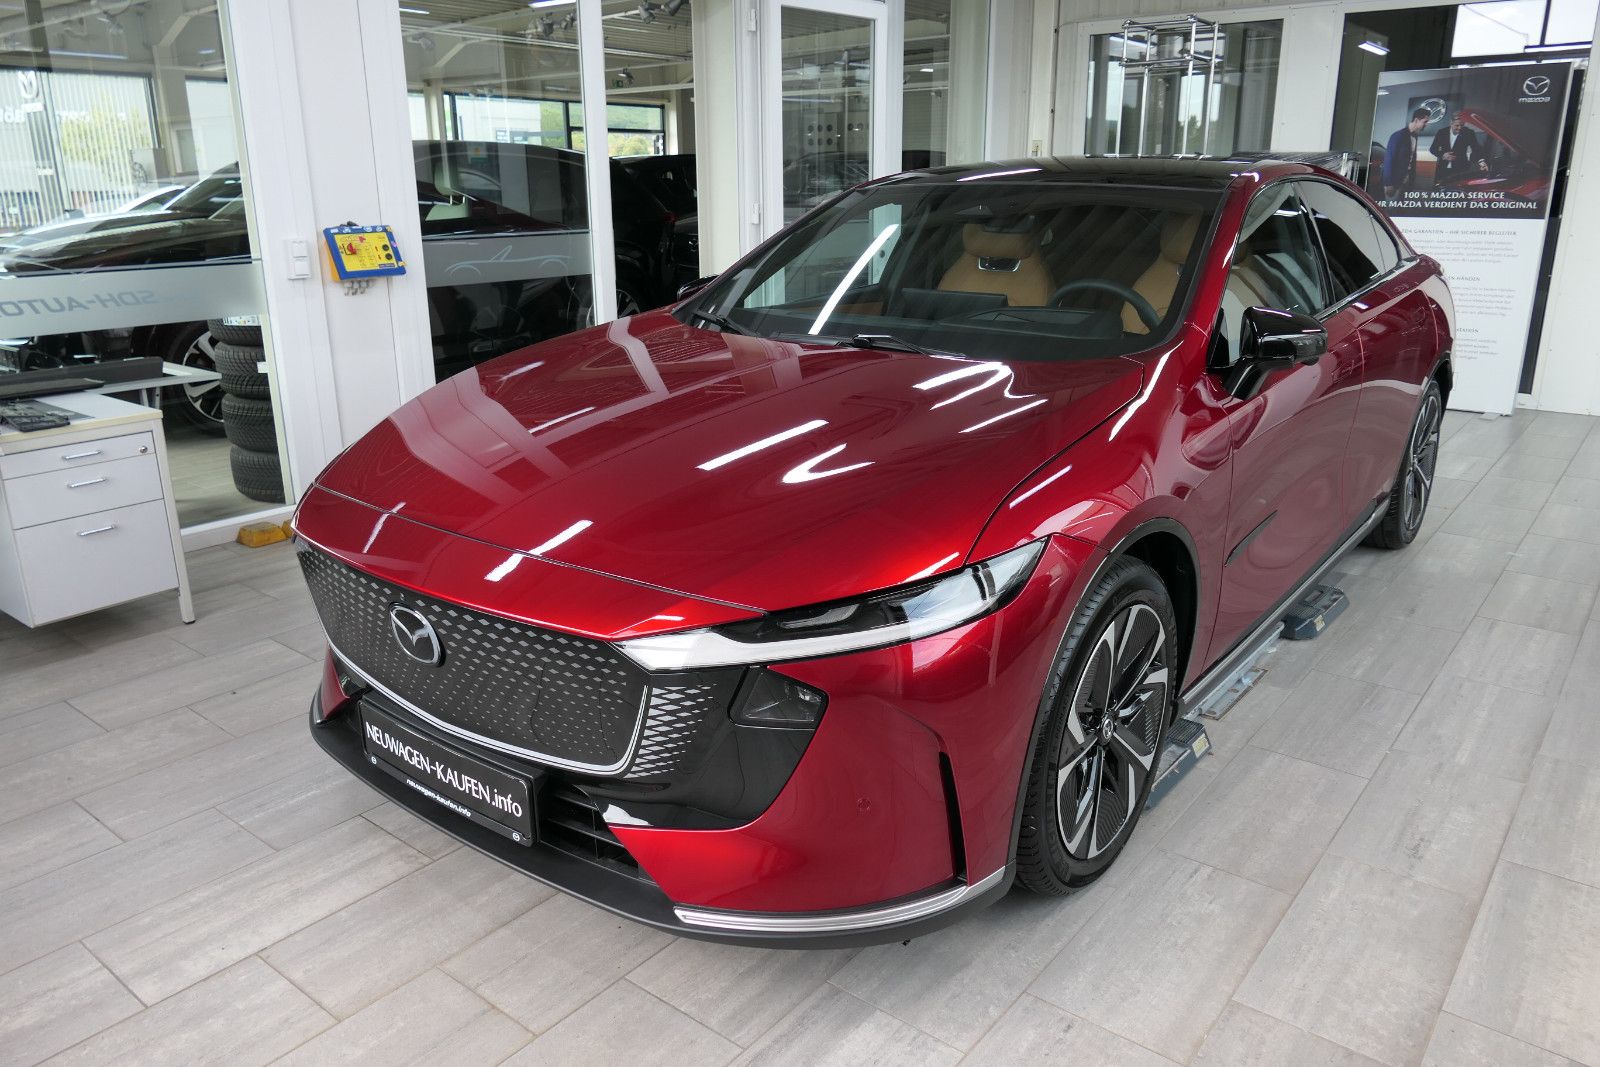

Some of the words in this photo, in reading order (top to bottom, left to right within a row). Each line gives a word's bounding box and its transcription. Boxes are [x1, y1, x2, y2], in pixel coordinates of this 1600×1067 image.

[1389, 200, 1422, 208] MAZDA
[1424, 200, 1468, 209] VERDIENT
[1470, 201, 1489, 209] DAS
[1491, 201, 1538, 209] ORIGINAL
[1404, 191, 1420, 199] 100
[1421, 191, 1429, 199] %
[1430, 191, 1466, 199] MAZDA
[1467, 191, 1505, 199] SERVICE
[365, 722, 523, 818] NEUWAGEN-KAUFEN.info
[406, 779, 471, 817] neuwagen-kaufen.info
